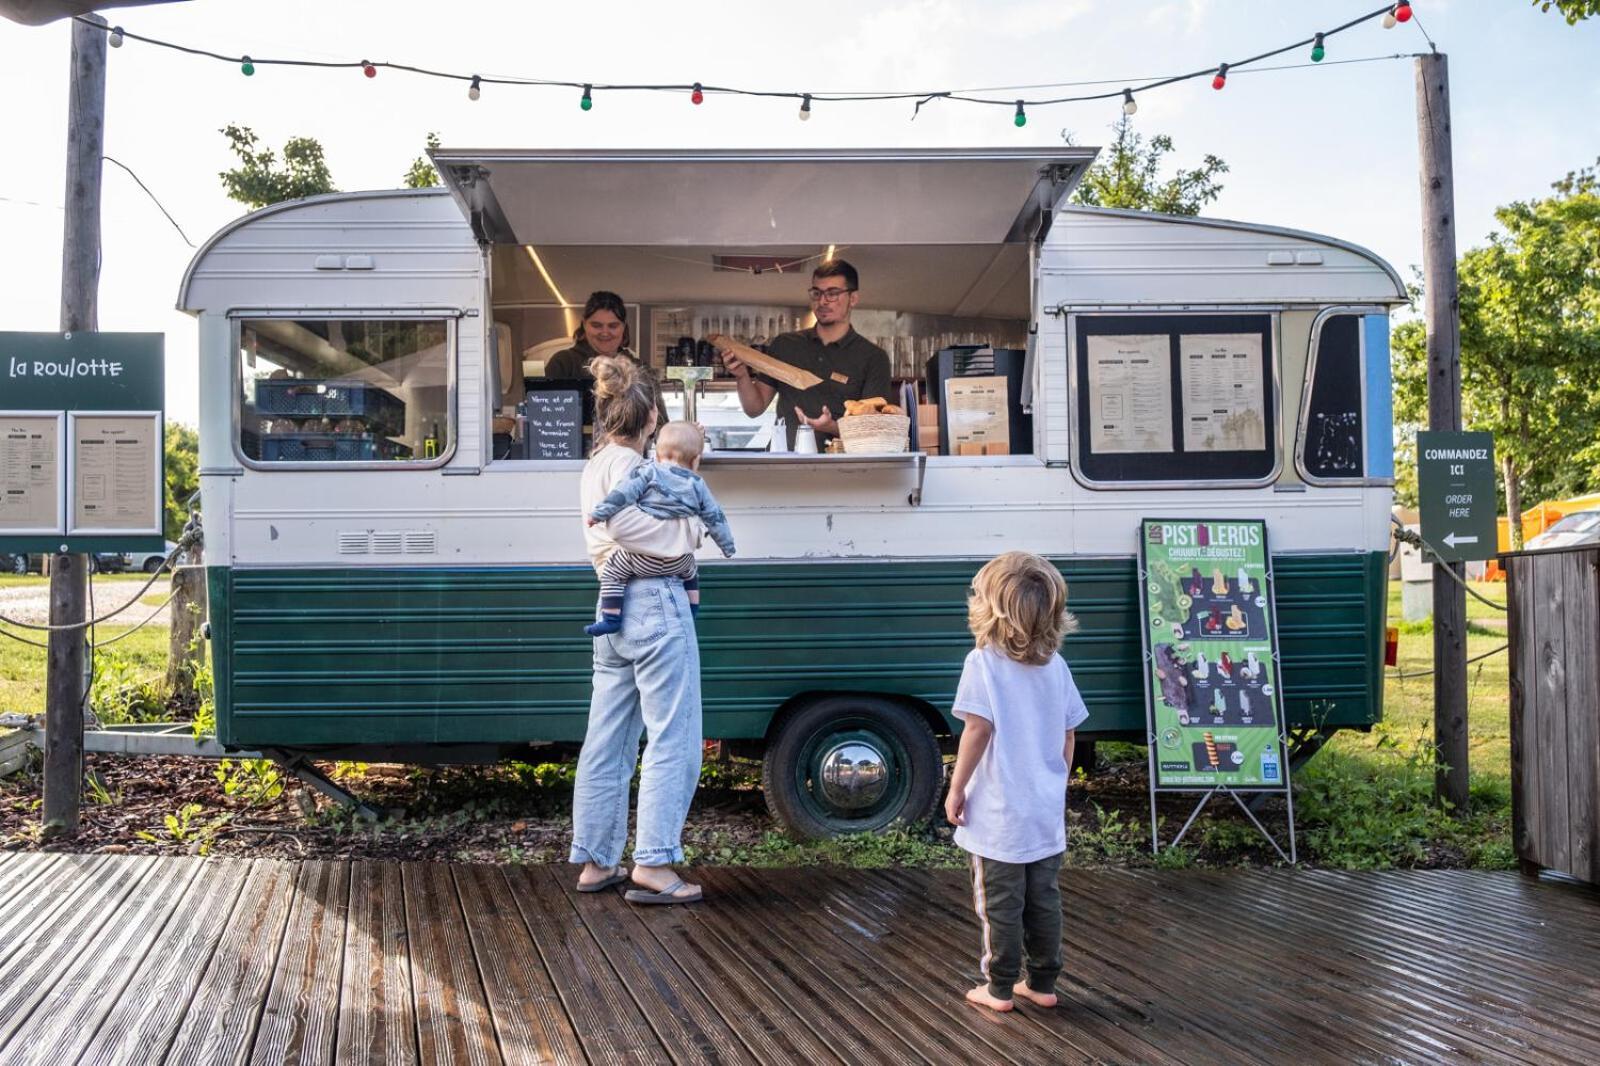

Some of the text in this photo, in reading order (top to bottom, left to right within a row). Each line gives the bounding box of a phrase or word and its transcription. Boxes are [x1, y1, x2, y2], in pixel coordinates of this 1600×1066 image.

[1425, 449, 1488, 460] COMMANDEZ
[1450, 464, 1464, 475] ICI
[1445, 494, 1472, 504] ORDER
[1449, 508, 1470, 517] HERE
